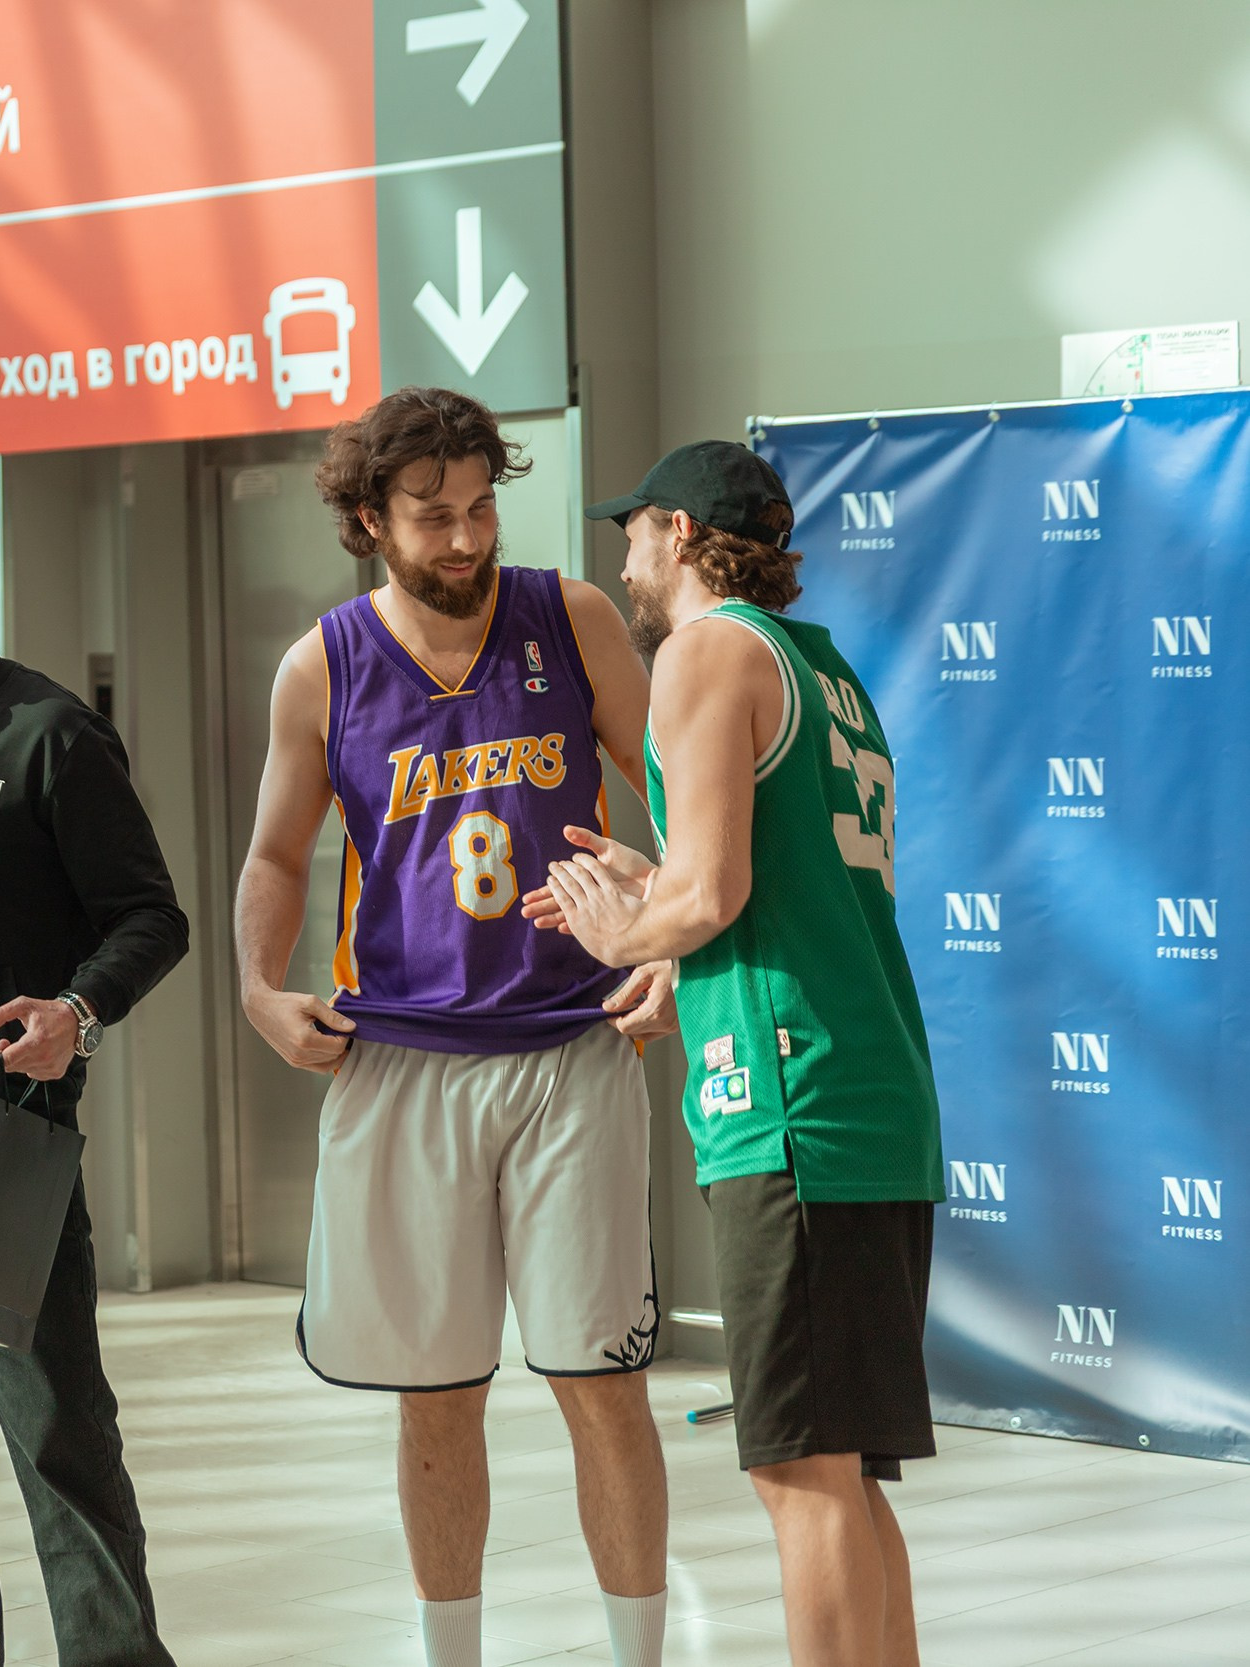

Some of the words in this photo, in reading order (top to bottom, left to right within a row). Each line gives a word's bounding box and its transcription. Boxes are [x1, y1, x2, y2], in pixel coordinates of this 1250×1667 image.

[86, 347, 113, 389] в
[124, 332, 258, 395] город
[841, 490, 896, 530] NN
[1042, 479, 1099, 521] NN
[841, 537, 895, 550] FITNESS
[1042, 527, 1101, 542] FITNESS
[940, 621, 997, 661] NN
[1151, 616, 1211, 657] NN
[940, 669, 998, 682] FITNESS
[1150, 665, 1212, 678] FITNESS
[384, 732, 568, 825] LAKERS
[1046, 757, 1105, 797] NN
[1046, 804, 1105, 819] FITNESS
[448, 810, 520, 921] 8
[944, 892, 1002, 931] NN
[1155, 897, 1218, 939] NN
[944, 939, 1002, 953] FITNESS
[1155, 945, 1219, 960] FITNESS
[1051, 1032, 1110, 1073] NN
[1050, 1079, 1110, 1095] FITNESS
[949, 1160, 1007, 1202] NN
[1160, 1176, 1222, 1220] NN
[949, 1207, 1008, 1223] FITNESS
[1161, 1224, 1223, 1241] FITNESS
[1053, 1304, 1116, 1347] NN
[1050, 1352, 1113, 1369] FITNESS
